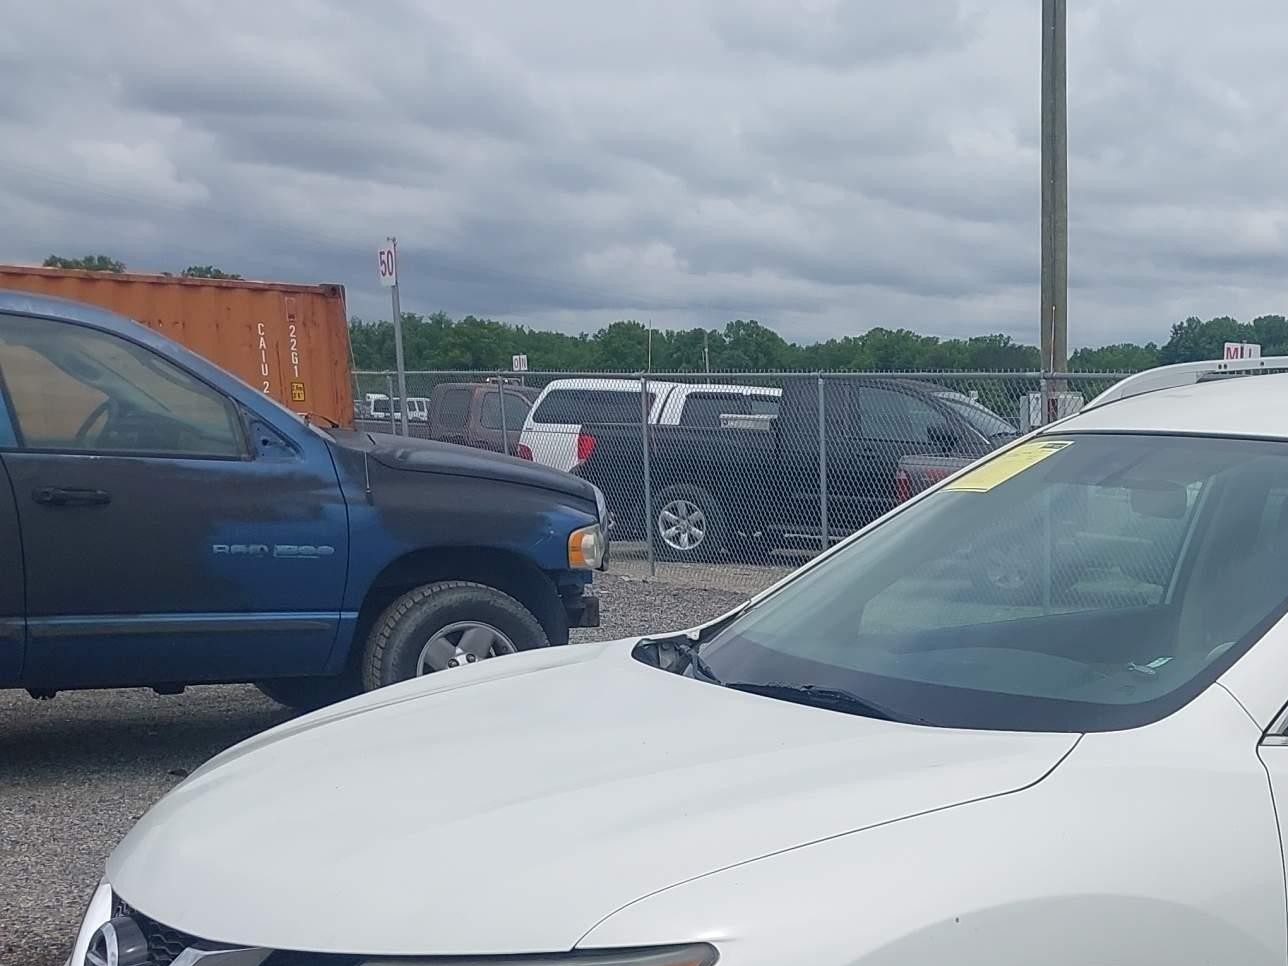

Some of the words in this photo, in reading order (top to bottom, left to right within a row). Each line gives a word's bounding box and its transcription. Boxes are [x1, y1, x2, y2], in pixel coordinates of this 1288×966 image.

[379, 250, 394, 277] 50
[257, 322, 269, 376] CAIU
[288, 324, 299, 378] 22G1
